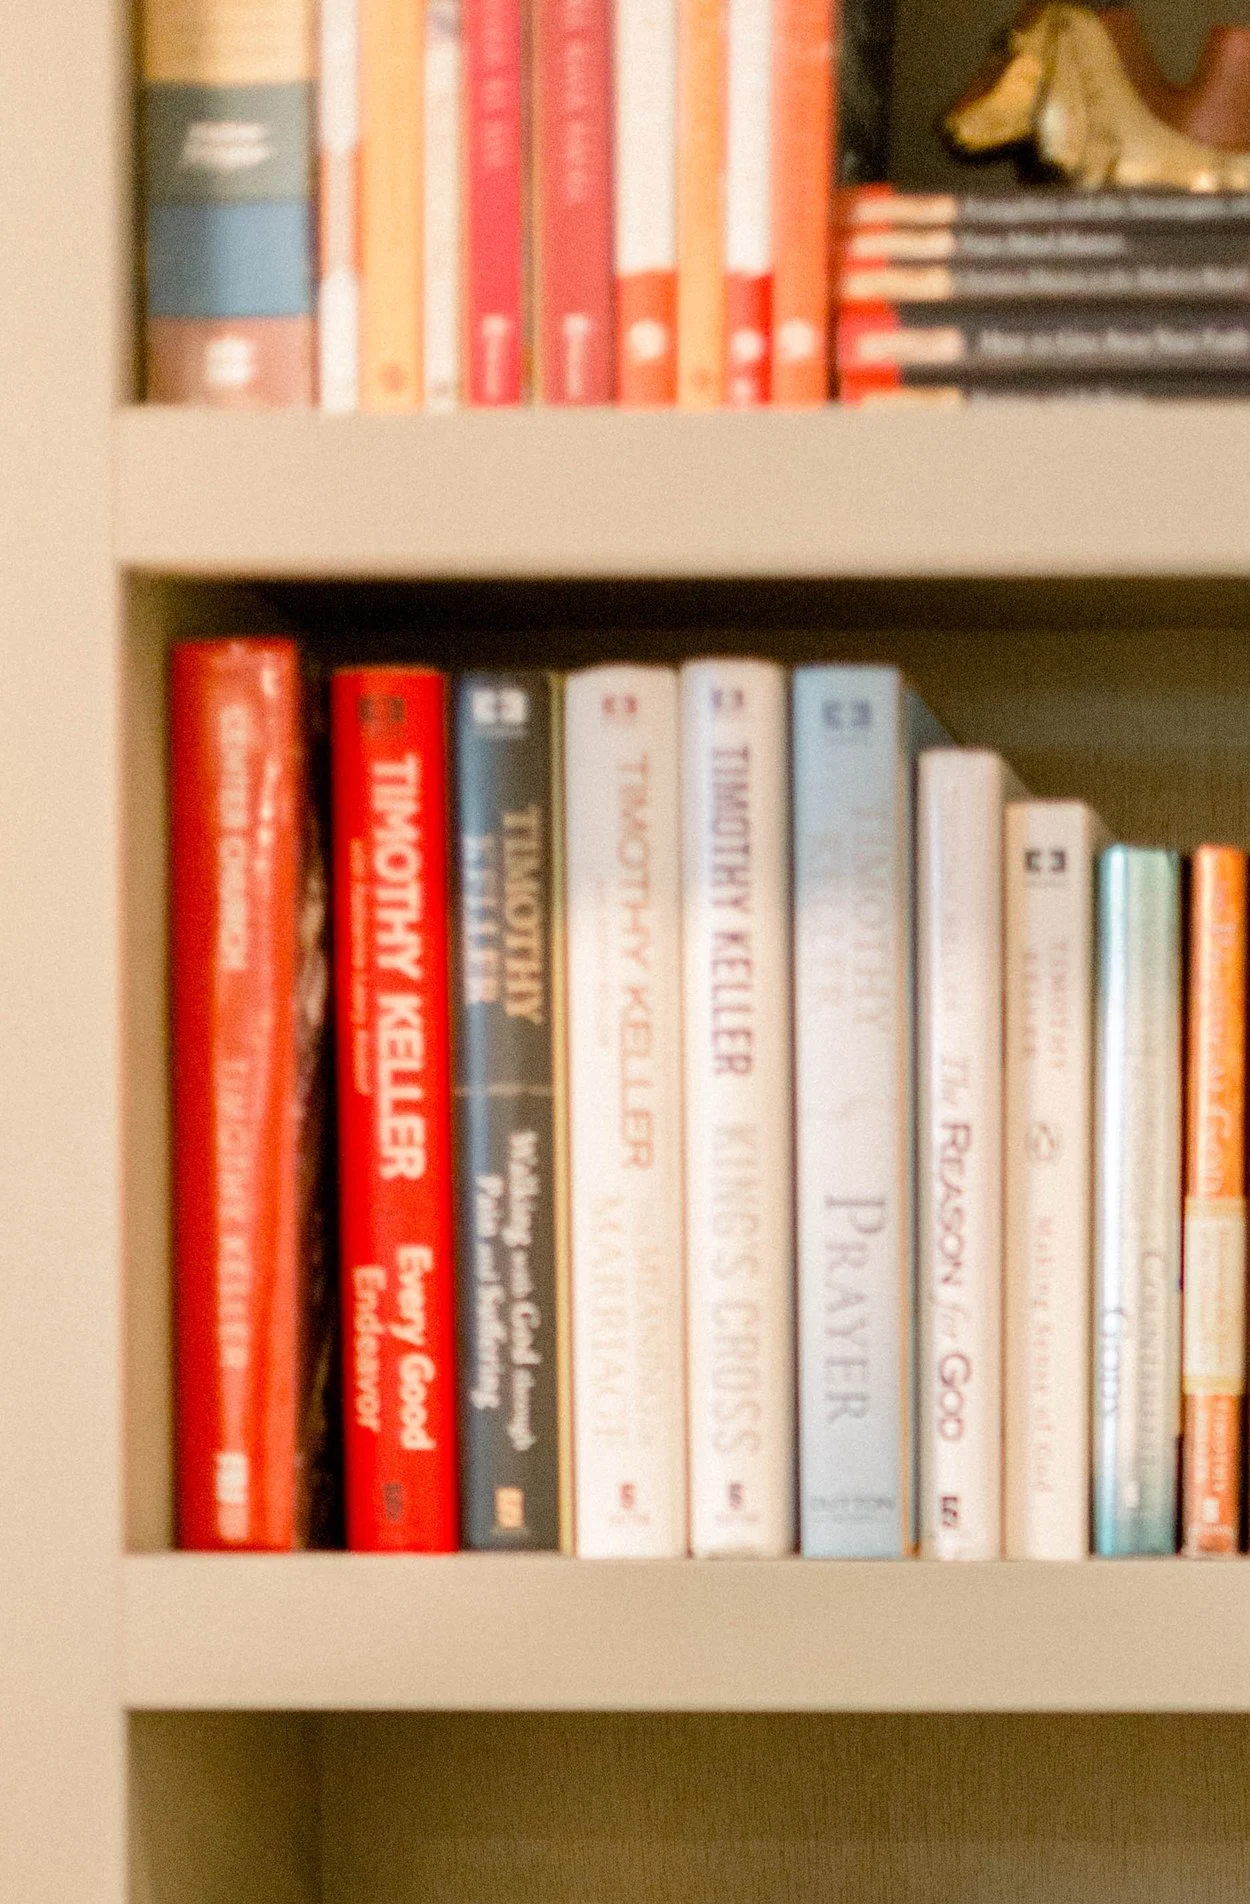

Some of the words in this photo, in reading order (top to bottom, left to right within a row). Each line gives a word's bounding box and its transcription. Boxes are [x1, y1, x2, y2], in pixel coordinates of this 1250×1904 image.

[372, 754, 424, 980] TIMOTHY
[617, 752, 651, 970] TIMOTHY
[710, 744, 752, 914] TIMOTHY
[464, 833, 499, 1005] KELLER
[502, 806, 542, 1024] TIMOTHY
[618, 986, 655, 1170] KELLER
[710, 931, 755, 1077] KELLER
[372, 992, 426, 1180] KELLER
[474, 1174, 504, 1237] Pain
[477, 1243, 499, 1281] and
[502, 1131, 538, 1246] Walking
[712, 1123, 762, 1279] KING'S
[939, 1122, 972, 1286] REASON
[353, 1266, 389, 1434] Endeavor
[389, 1245, 436, 1346] Every
[470, 1286, 506, 1410] Suffering
[511, 1301, 542, 1364] God
[824, 1194, 891, 1424] PRAYER
[397, 1353, 437, 1451] Good
[712, 1300, 762, 1455] CROSS
[938, 1352, 972, 1443] GOD
[1035, 1442, 1055, 1493] God
